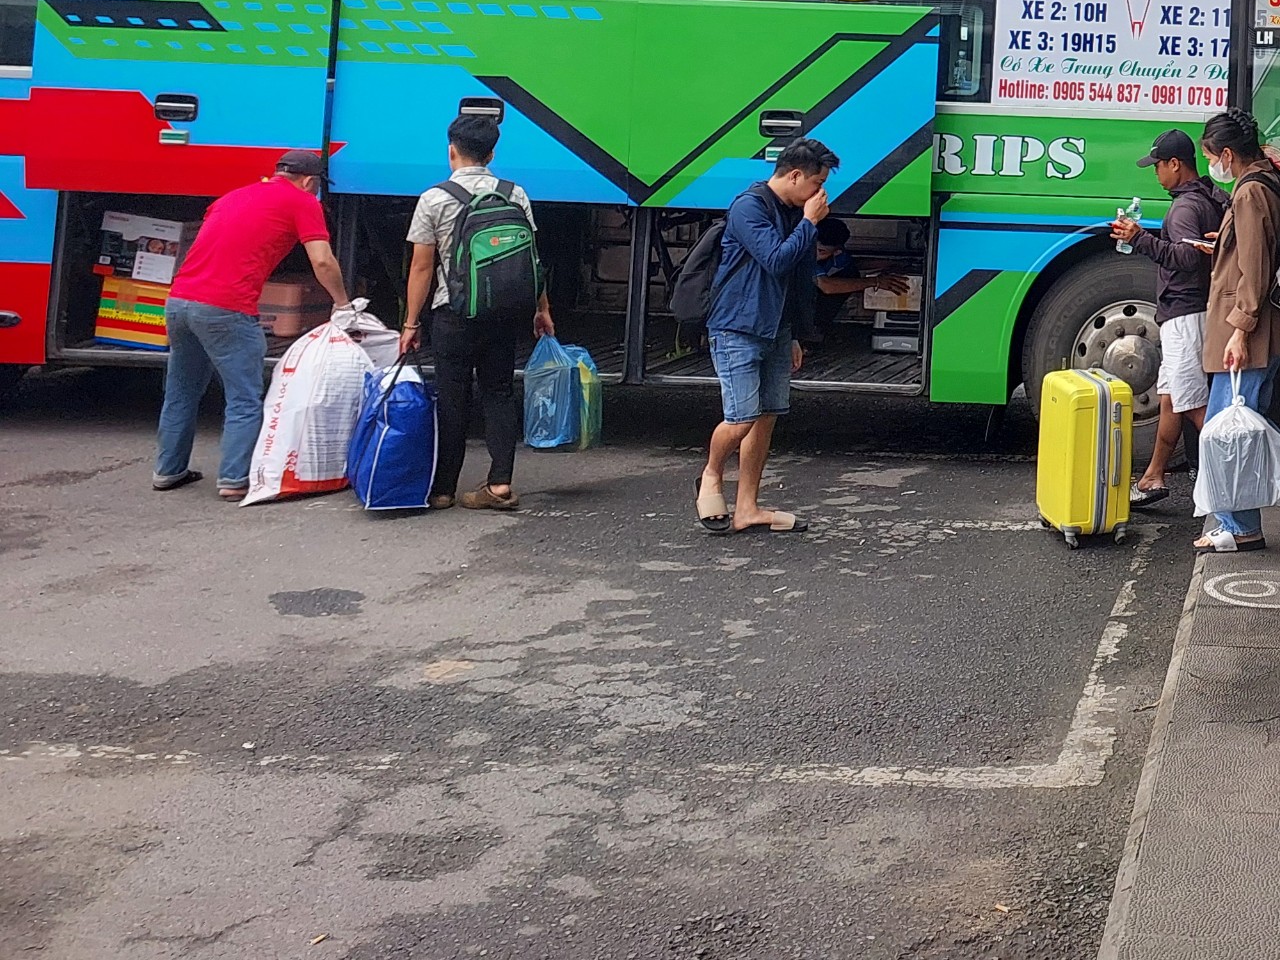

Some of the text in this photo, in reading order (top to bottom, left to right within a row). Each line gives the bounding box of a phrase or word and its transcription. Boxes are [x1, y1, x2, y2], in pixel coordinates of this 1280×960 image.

[1021, 0, 1107, 22] XE 2: 10H
[1160, 5, 1183, 25] XE
[1188, 7, 1205, 26] 2:
[1008, 30, 1116, 53] XE 3: 19H15
[1158, 36, 1181, 56] XE
[1187, 37, 1203, 56] 3:
[1256, 31, 1273, 45] LH
[1000, 55, 1022, 72] Có
[1028, 56, 1055, 73] Xe
[1061, 58, 1114, 78] Trung
[1119, 60, 1182, 80] Chuyển
[1186, 64, 1198, 78] 2
[999, 79, 1049, 99] Hotline:
[1053, 81, 1085, 101] 0905
[1089, 82, 1112, 102] 544
[1117, 83, 1141, 103] 837
[1152, 85, 1182, 105] 0981
[1188, 86, 1211, 106] 079
